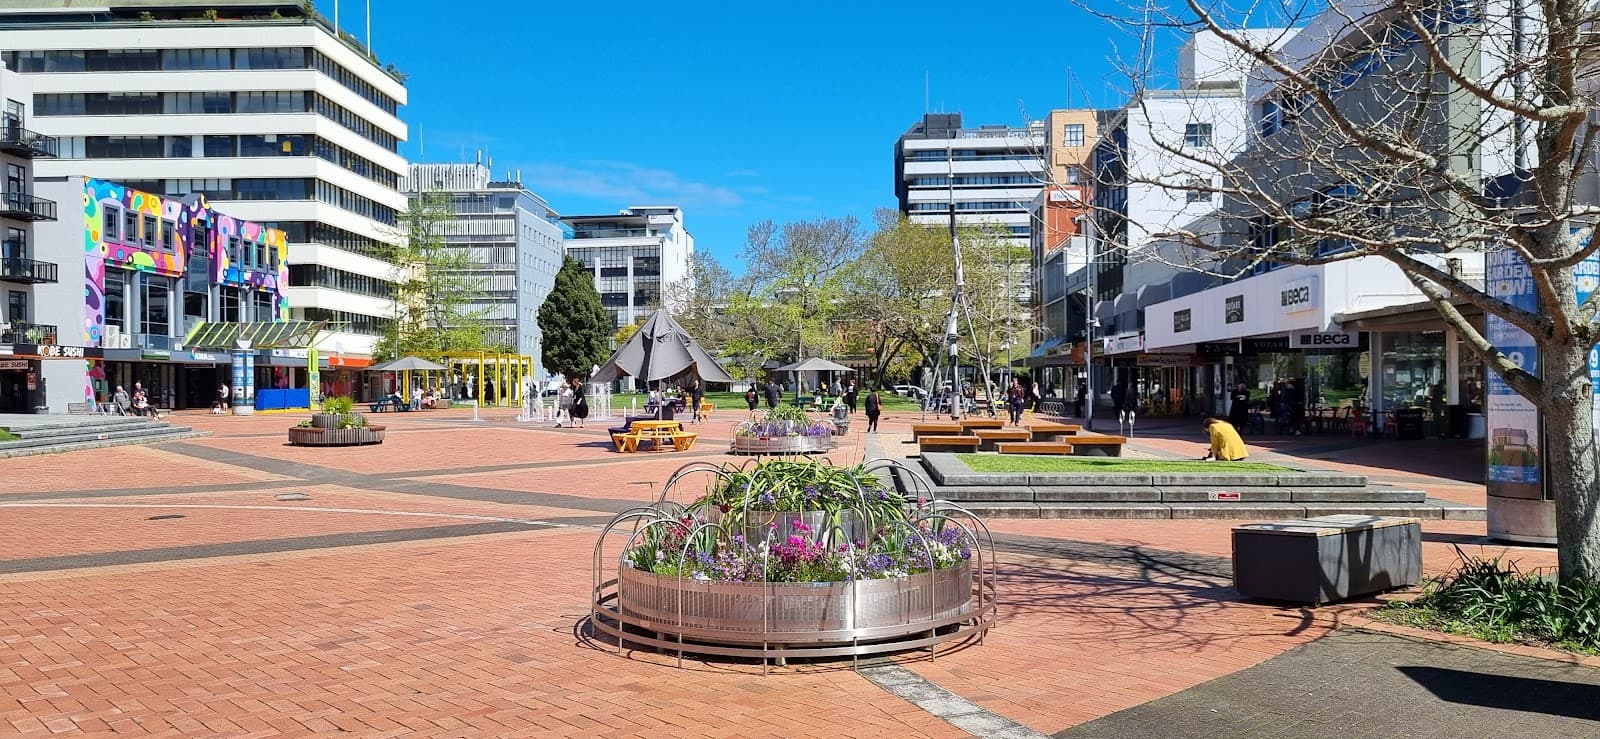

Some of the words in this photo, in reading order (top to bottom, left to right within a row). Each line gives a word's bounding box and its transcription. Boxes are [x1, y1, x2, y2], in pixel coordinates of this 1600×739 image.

[1288, 286, 1309, 305] Beca
[1313, 334, 1350, 344] Beca
[37, 345, 61, 356] KOBE
[63, 346, 85, 357] SUSHI
